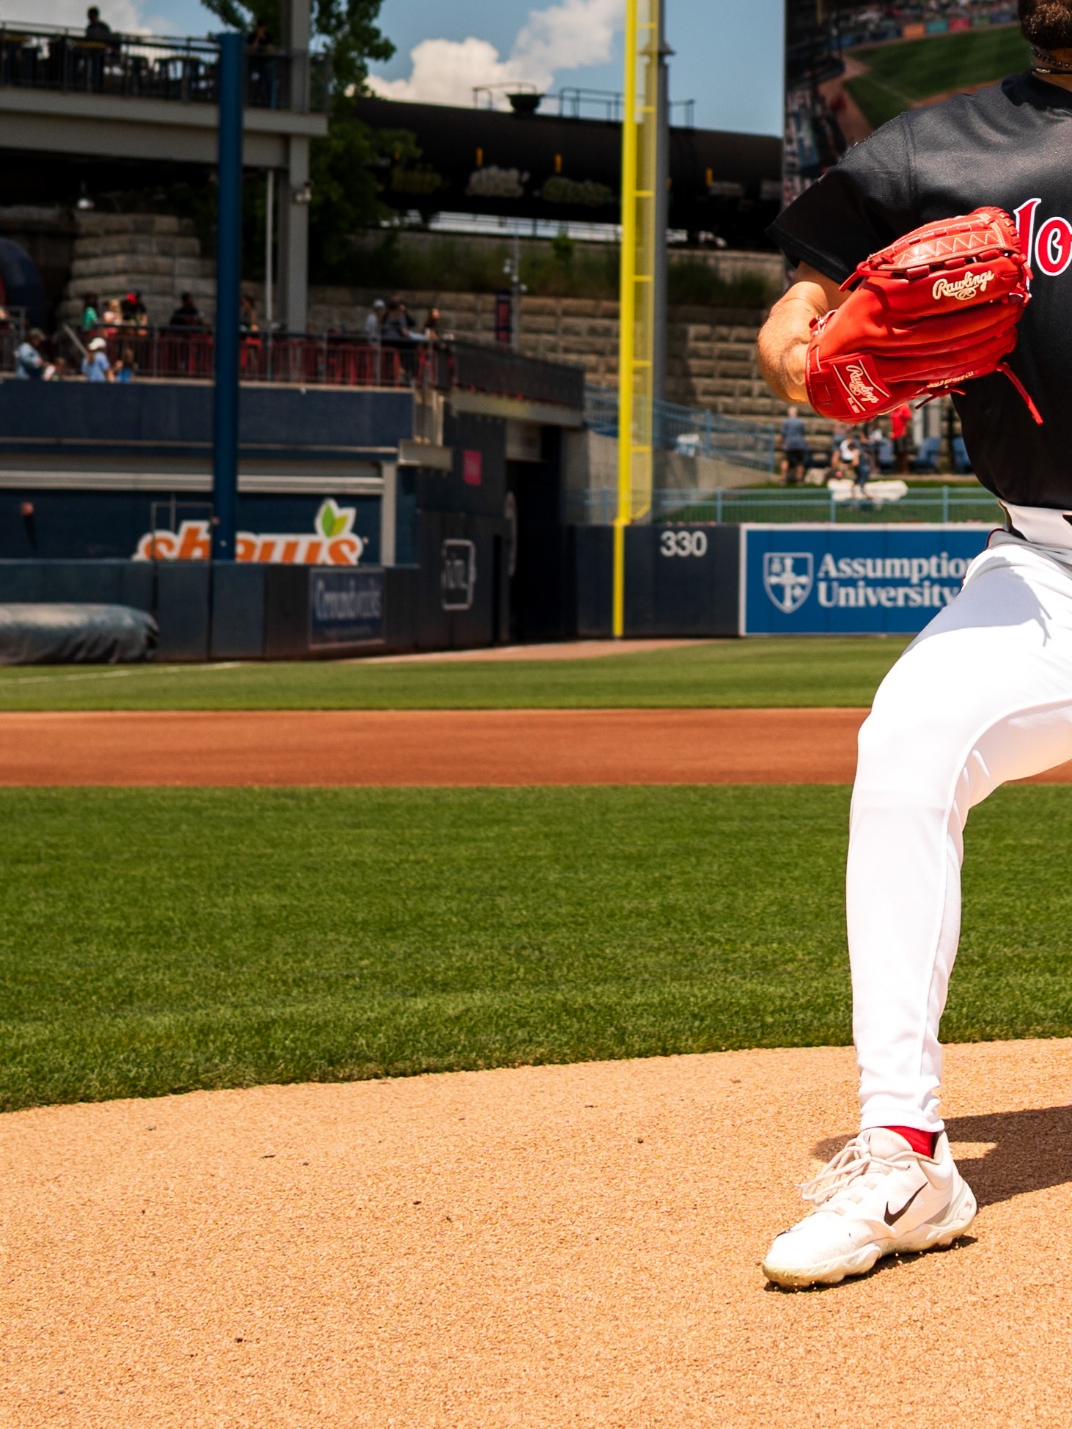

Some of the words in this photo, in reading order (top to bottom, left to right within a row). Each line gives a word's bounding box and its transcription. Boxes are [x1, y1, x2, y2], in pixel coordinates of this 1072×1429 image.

[932, 270, 994, 300] Rawlings
[845, 364, 879, 404] Rawlings
[660, 530, 707, 556] 330
[817, 552, 971, 583] Assumptio
